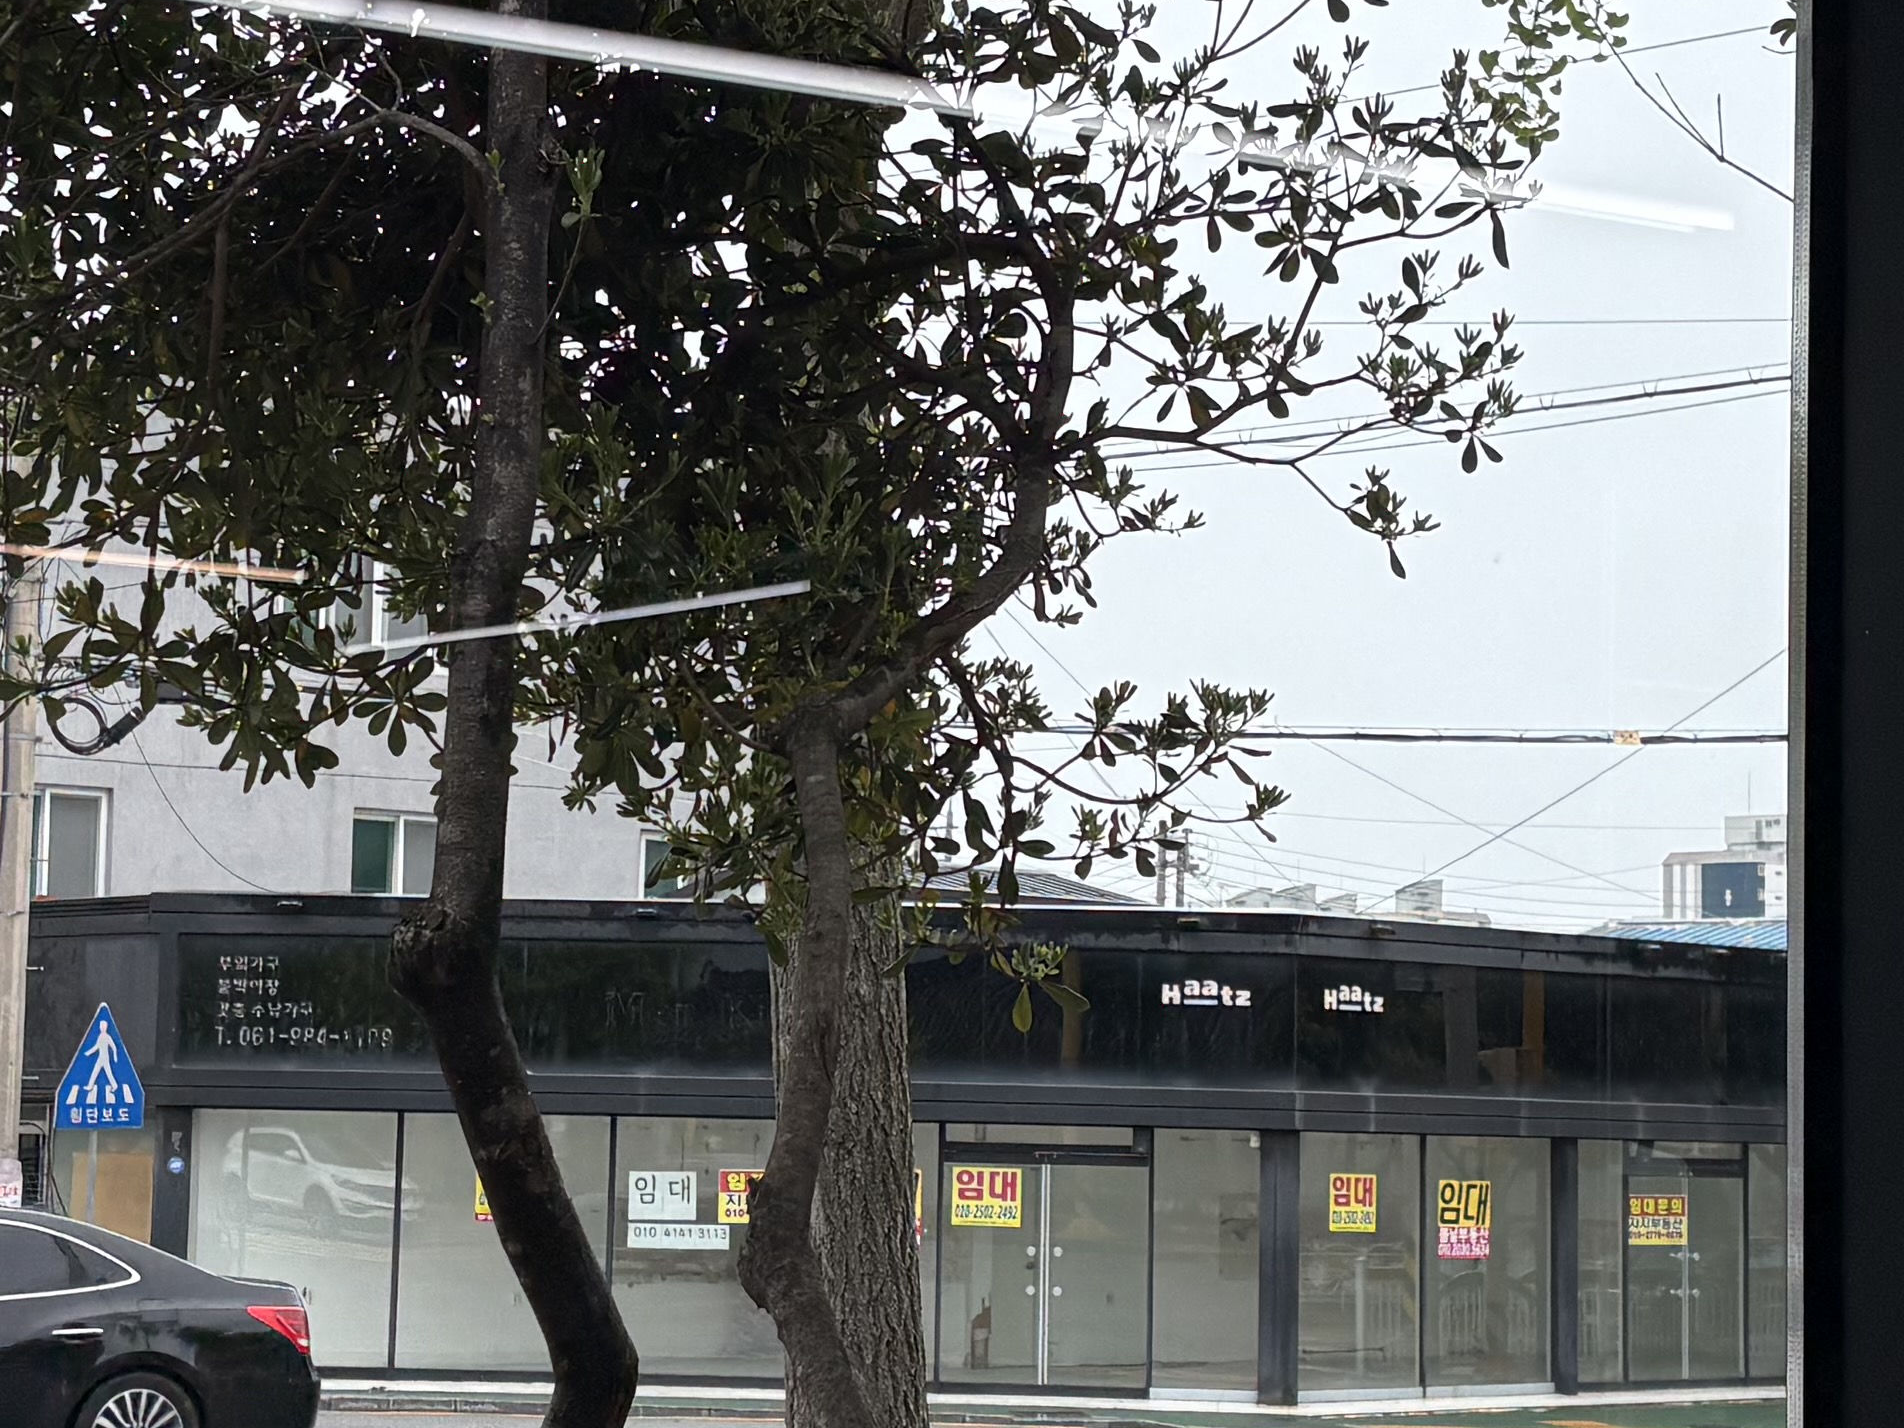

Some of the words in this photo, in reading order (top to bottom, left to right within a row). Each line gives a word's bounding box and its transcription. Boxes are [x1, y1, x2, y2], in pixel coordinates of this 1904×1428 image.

[1161, 979, 1252, 1007] Haatz
[1323, 984, 1384, 1013] Haatz
[70, 1107, 130, 1124] 횡단보도
[956, 1169, 1018, 1202] 임대
[1332, 1176, 1374, 1207] 임대
[1440, 1182, 1489, 1226] 임대
[634, 1226, 657, 1238] 010
